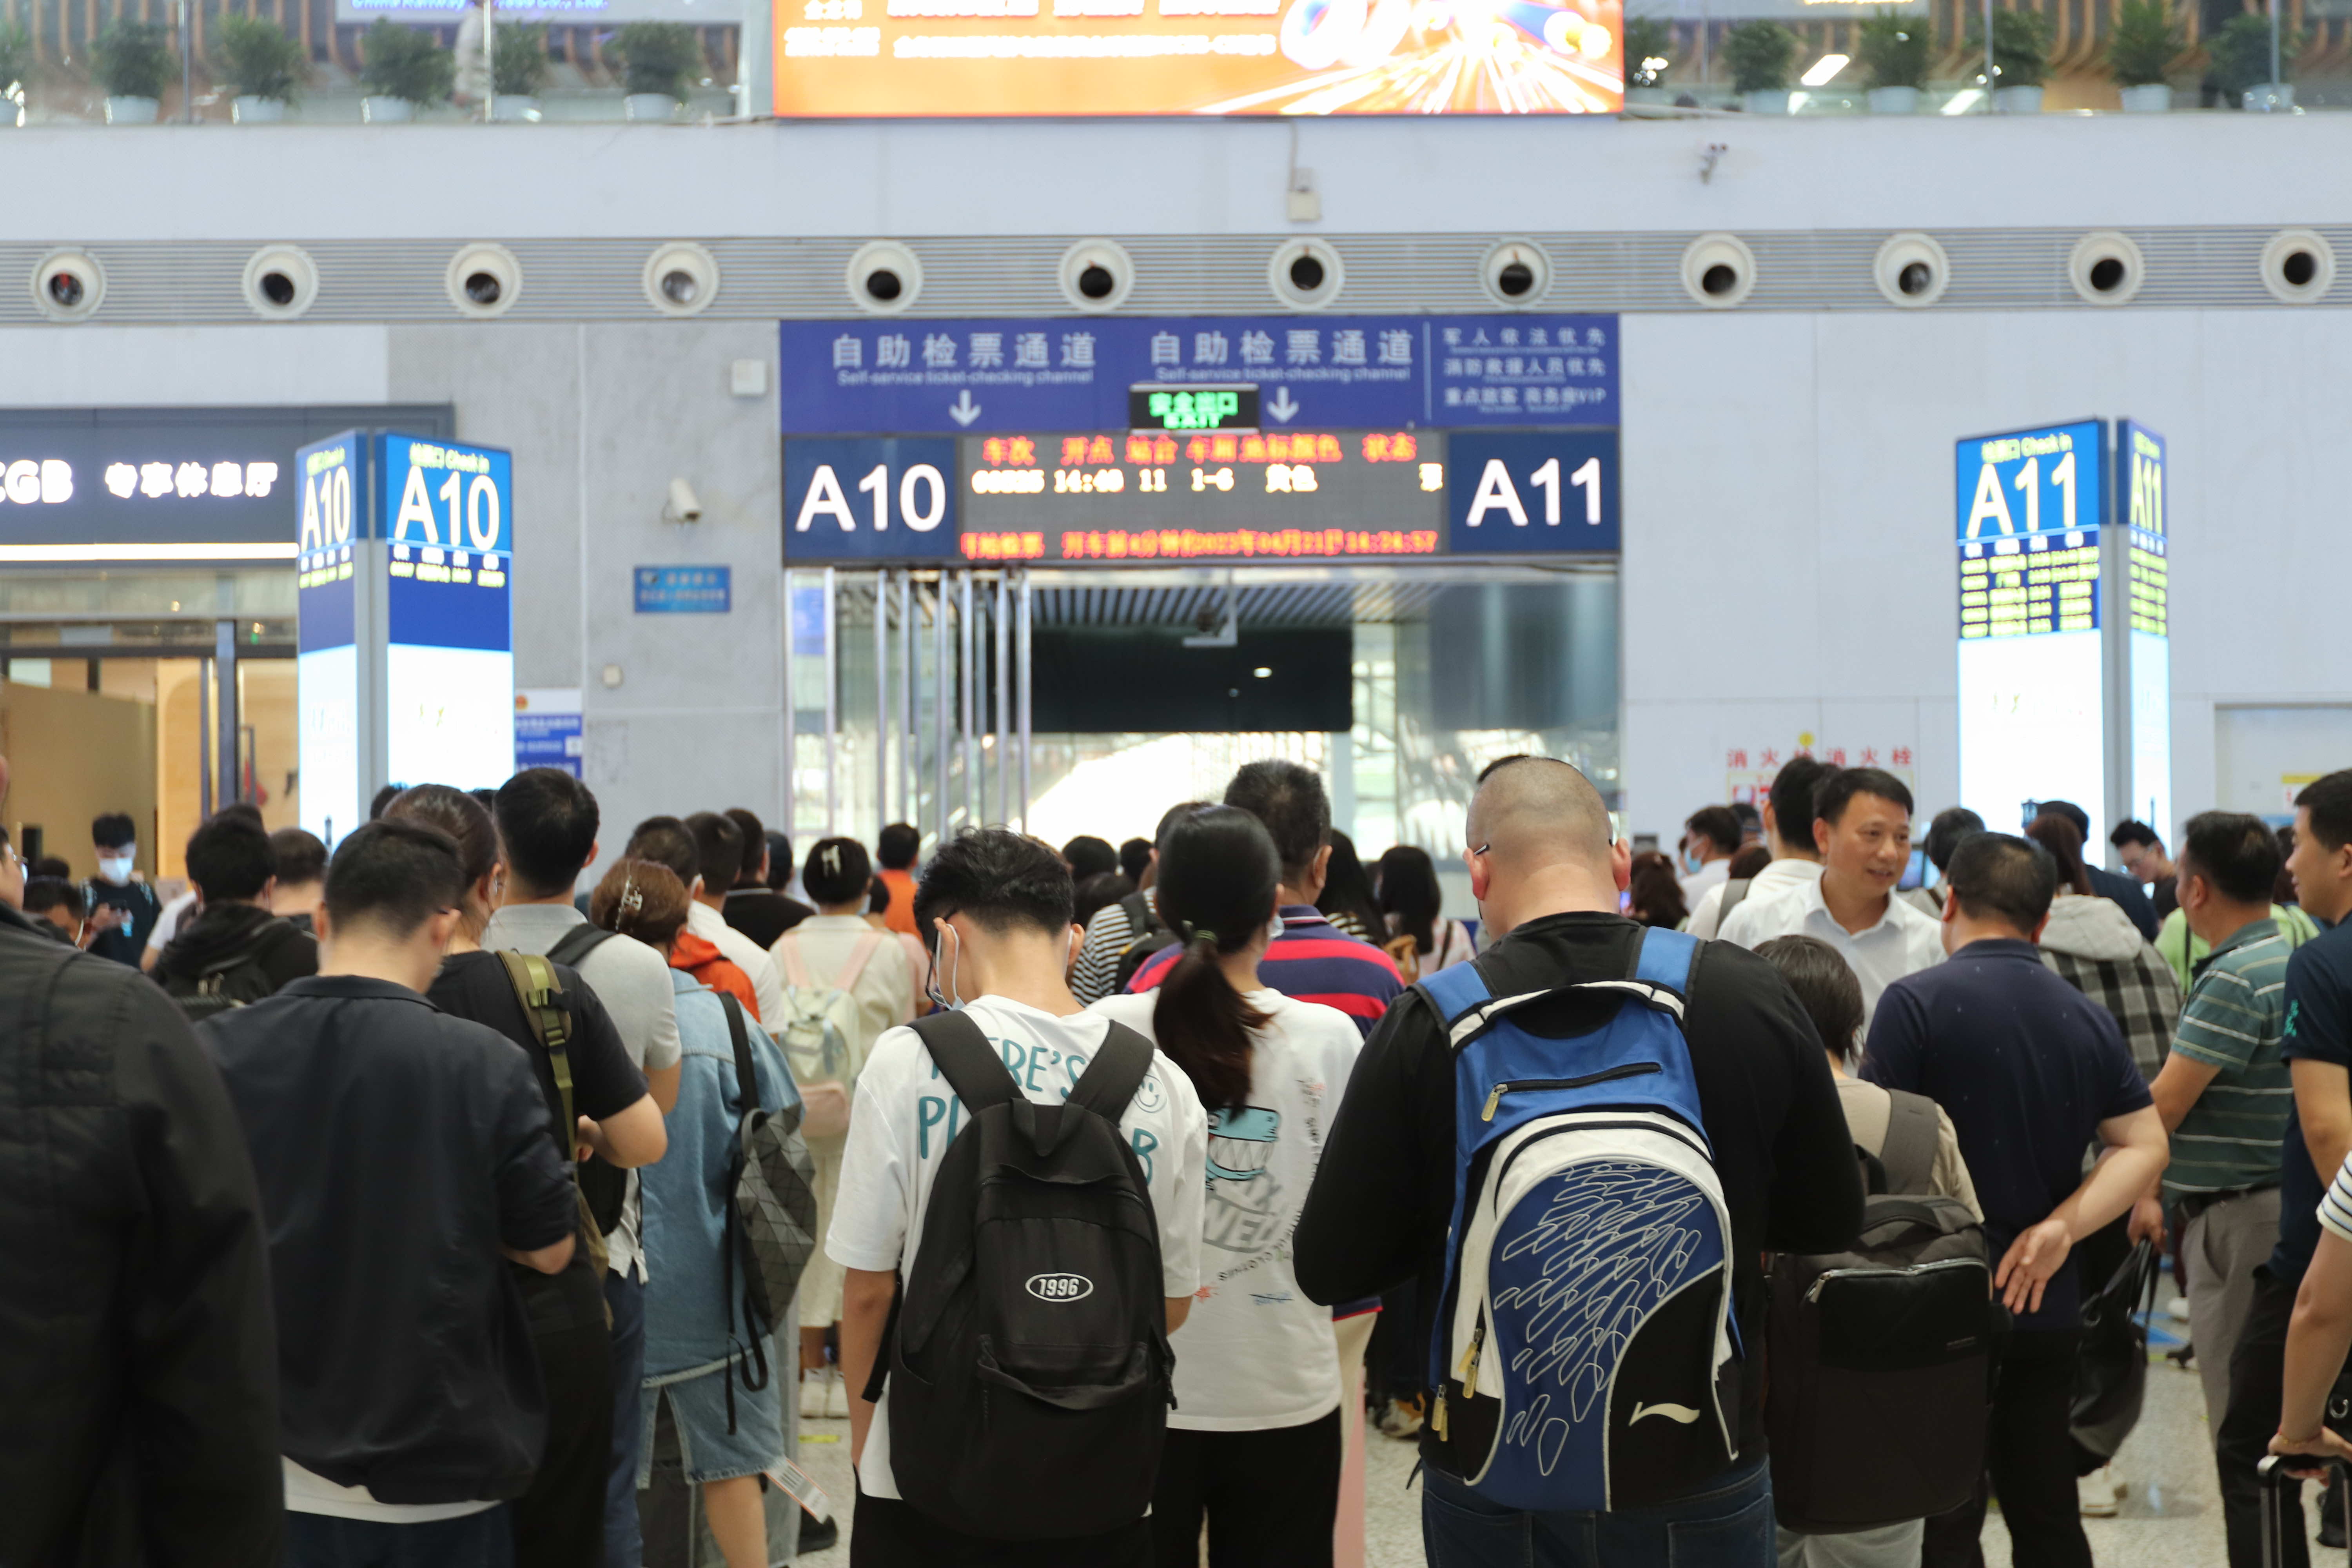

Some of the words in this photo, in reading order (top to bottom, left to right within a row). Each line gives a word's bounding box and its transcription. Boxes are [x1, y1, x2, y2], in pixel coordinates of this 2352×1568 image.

[833, 333, 1096, 368] 自助检票通道
[1151, 330, 1413, 365] 自助检票通道
[0, 459, 73, 505] GB
[301, 466, 350, 552] A10
[395, 465, 500, 551] A10
[795, 463, 946, 532] A10
[1139, 468, 1167, 492] 11
[1466, 457, 1601, 527] A11
[1966, 452, 2076, 539] A11
[2131, 452, 2162, 535] A11
[1039, 1278, 1079, 1296] 1996
